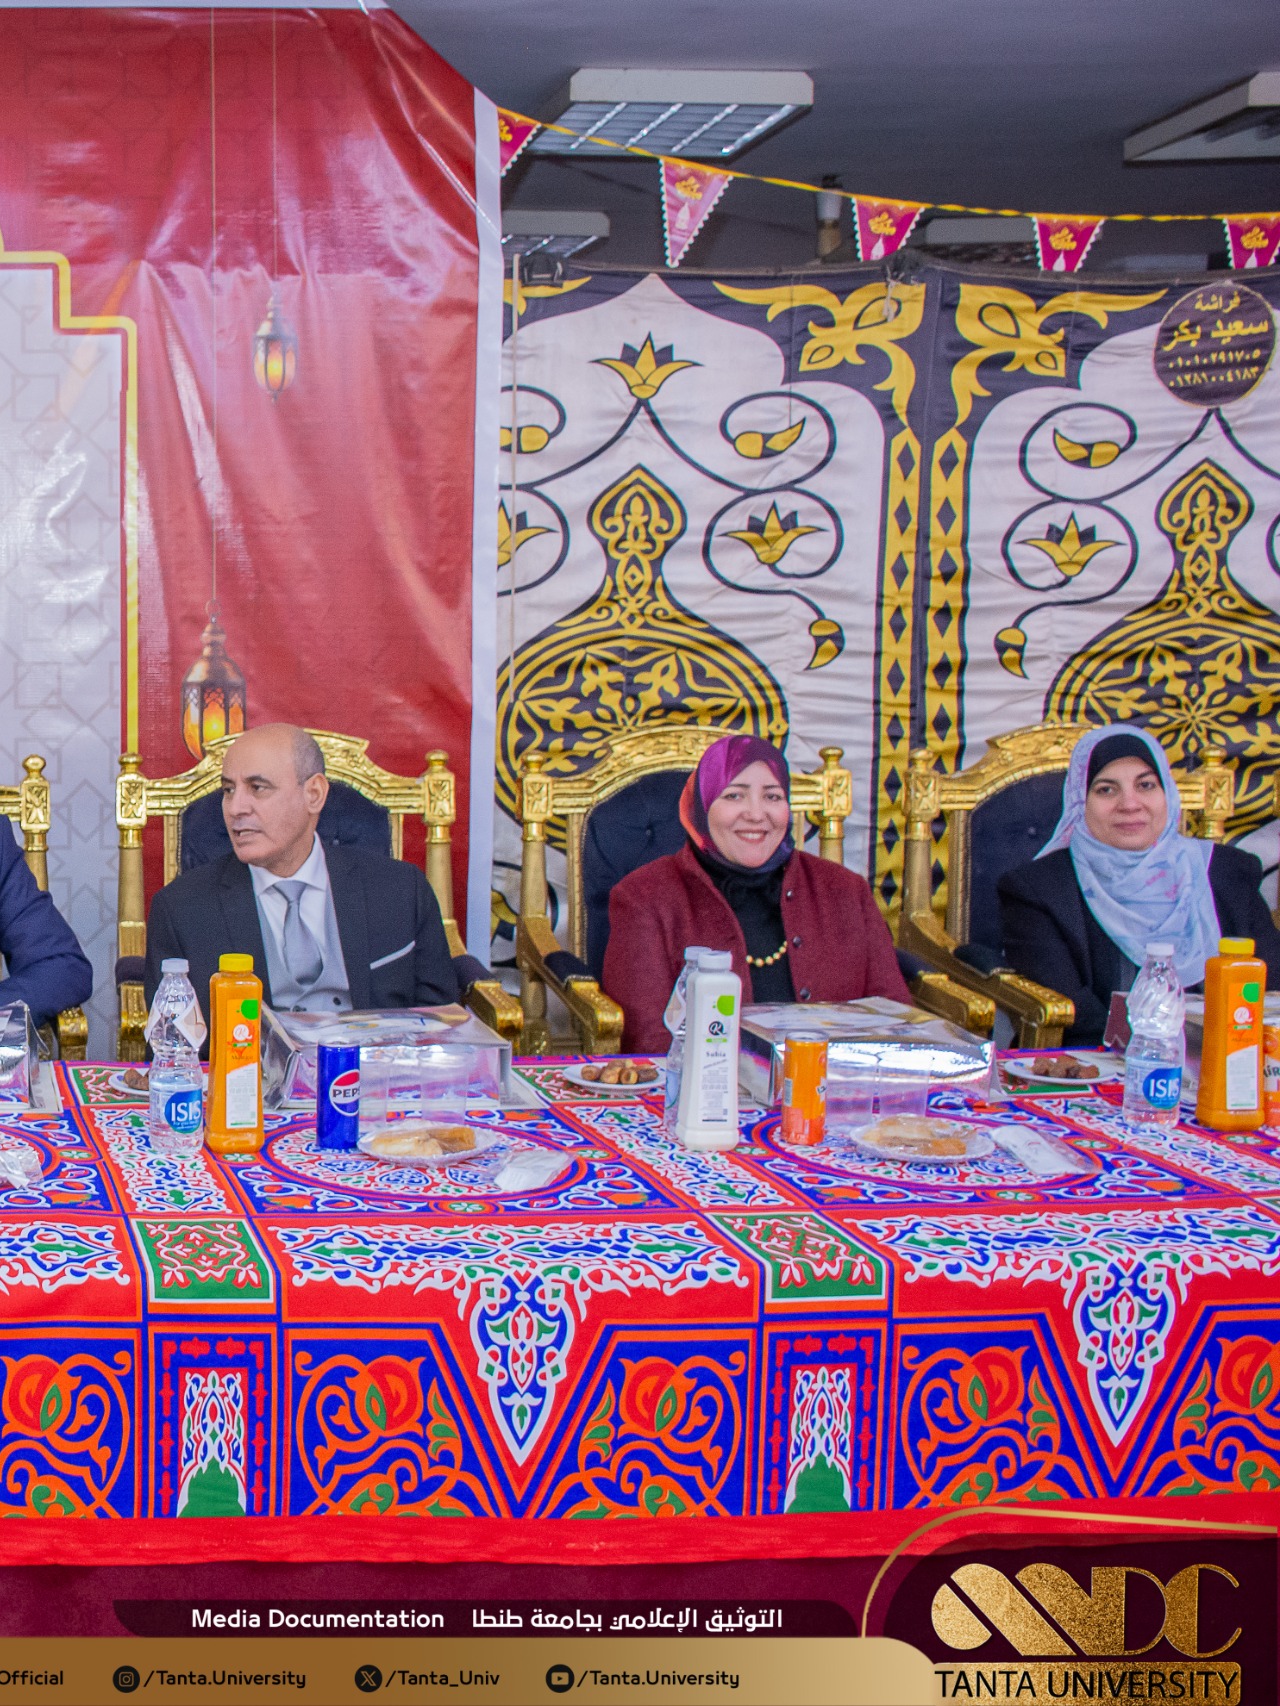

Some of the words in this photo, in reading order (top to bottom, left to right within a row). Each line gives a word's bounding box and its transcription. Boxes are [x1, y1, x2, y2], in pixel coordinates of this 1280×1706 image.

[1195, 290, 1241, 313] فراشة
[1162, 319, 1202, 351] بكر
[1210, 319, 1269, 345] سعيد
[1149, 1077, 1180, 1098] ISIS
[171, 1100, 201, 1122] ISIS
